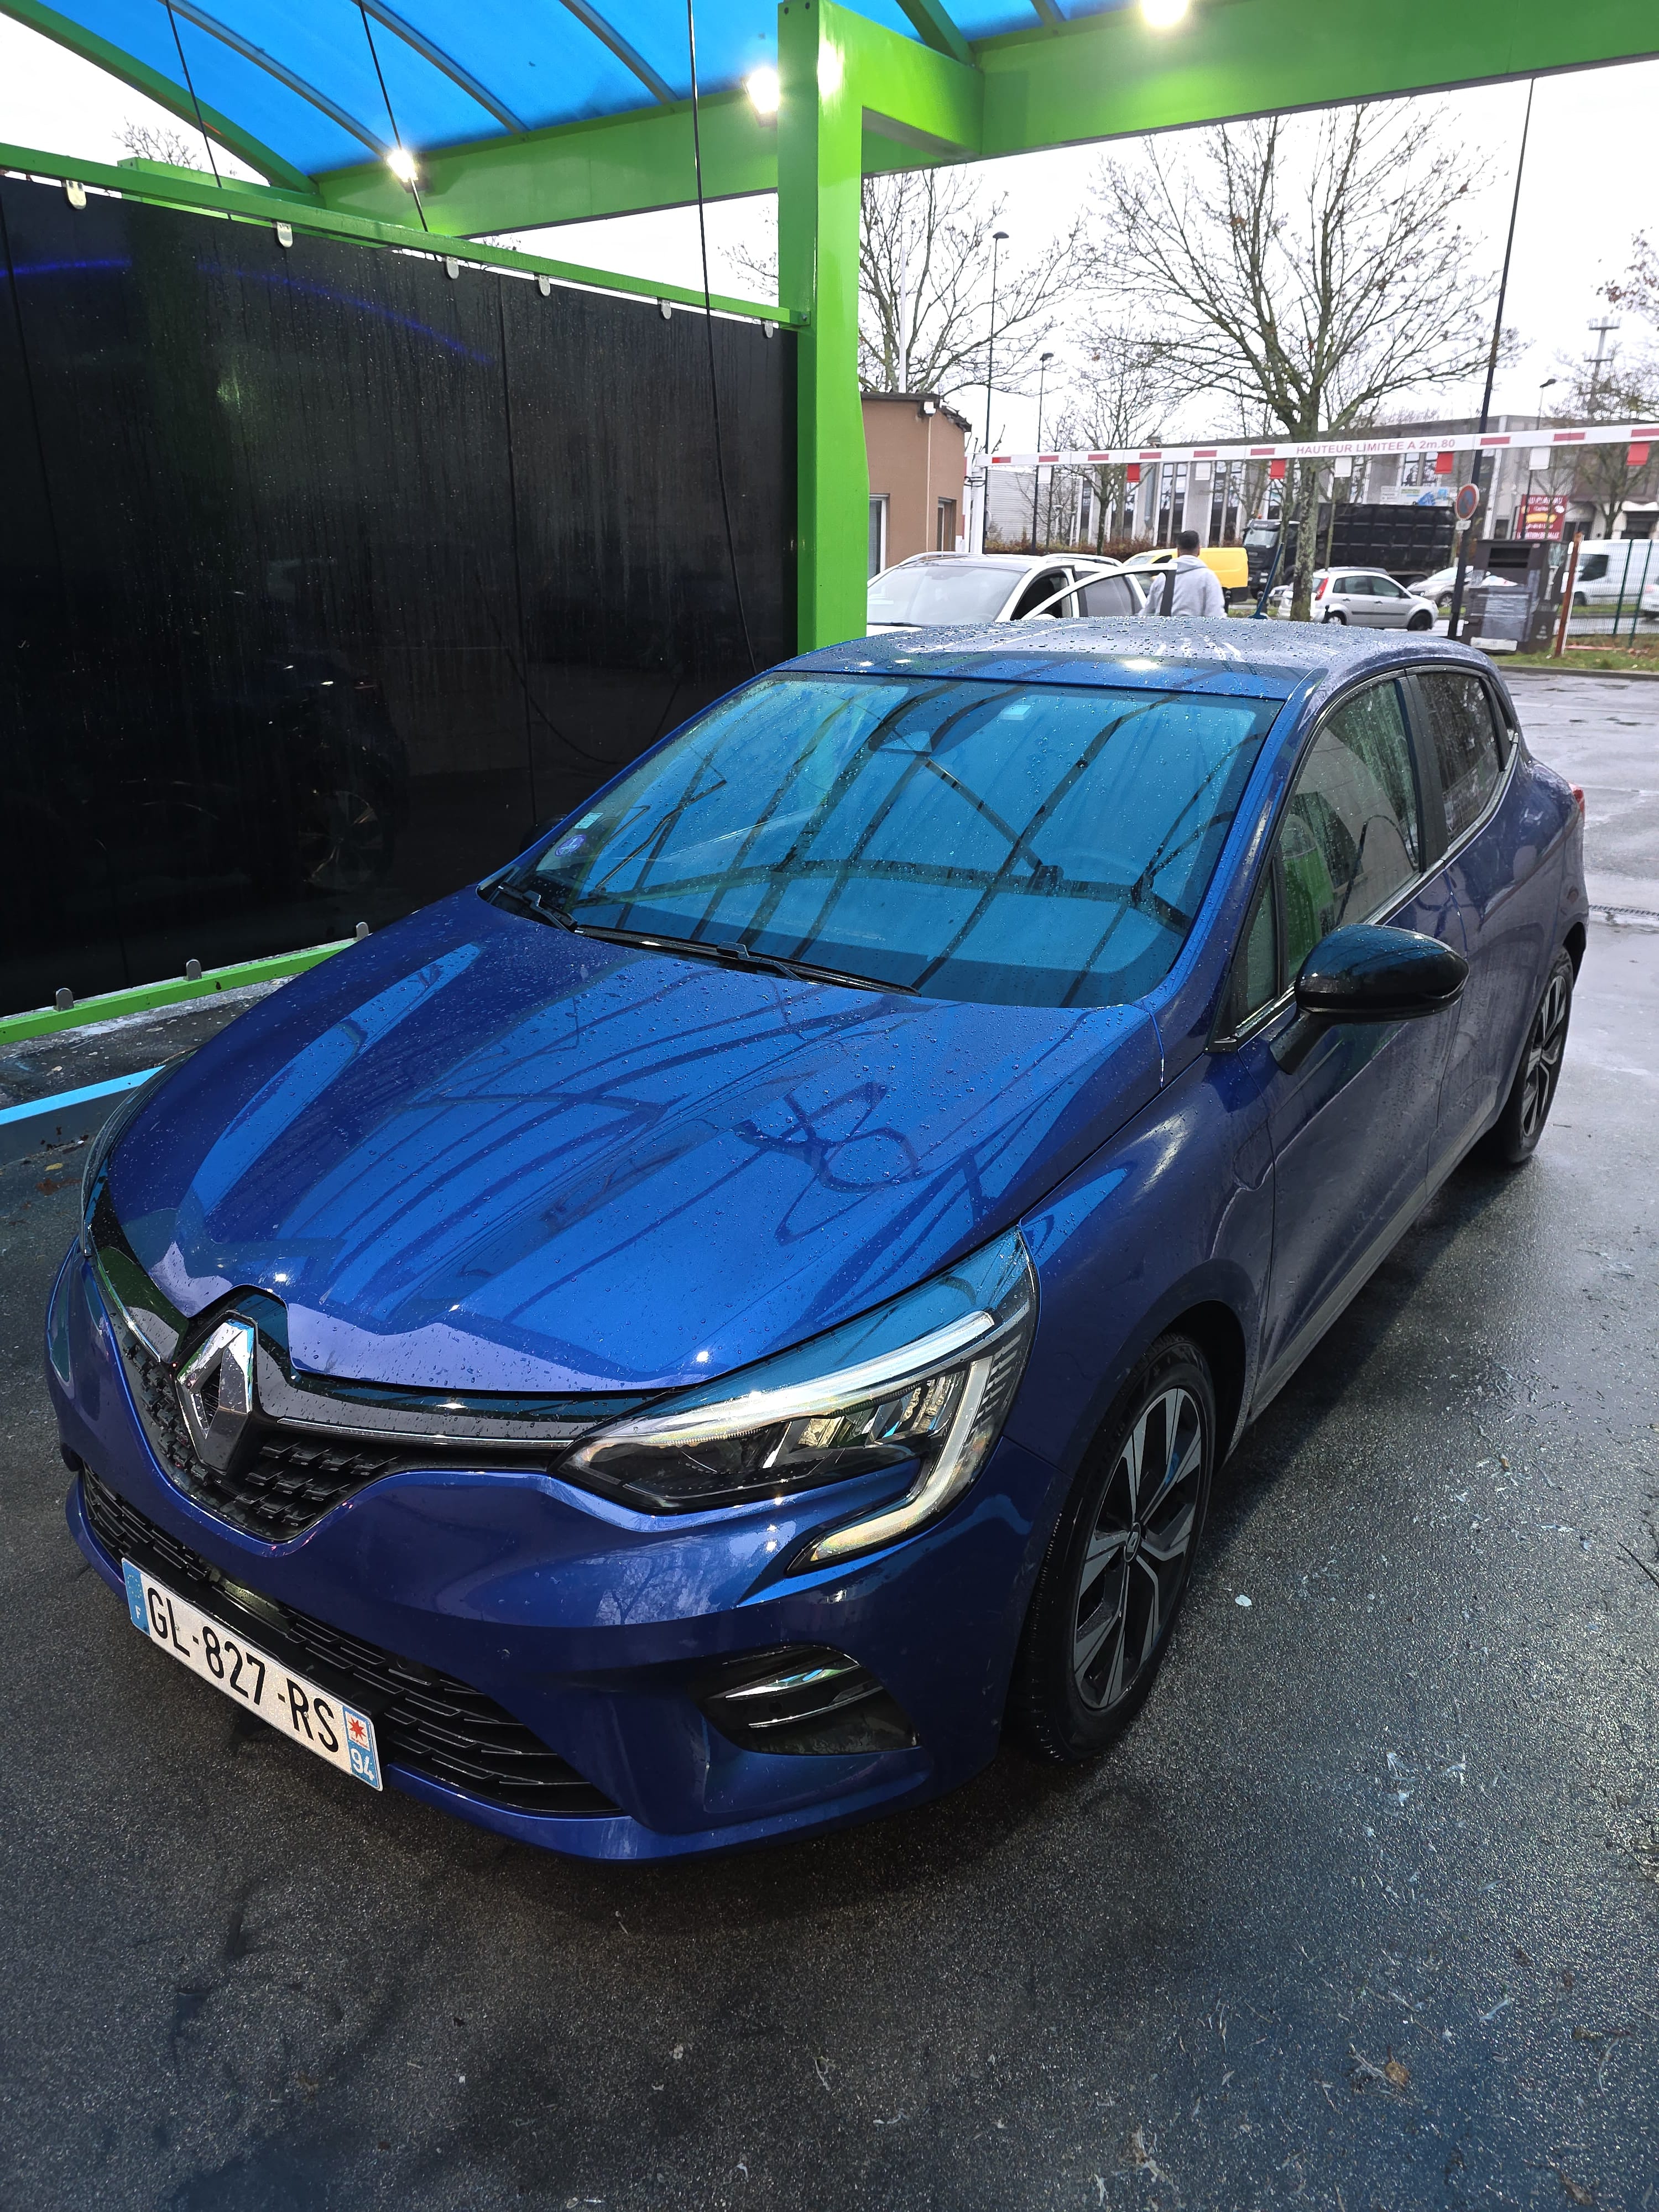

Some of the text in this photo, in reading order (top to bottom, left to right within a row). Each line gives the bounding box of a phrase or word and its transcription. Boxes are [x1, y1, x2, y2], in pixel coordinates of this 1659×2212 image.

[1296, 444, 1353, 455] HAUTEUR
[1357, 441, 1404, 452] LIMITEE
[135, 1605, 141, 1619] F
[147, 1587, 339, 1753] GL-827-RS
[351, 1748, 375, 1781] 94
